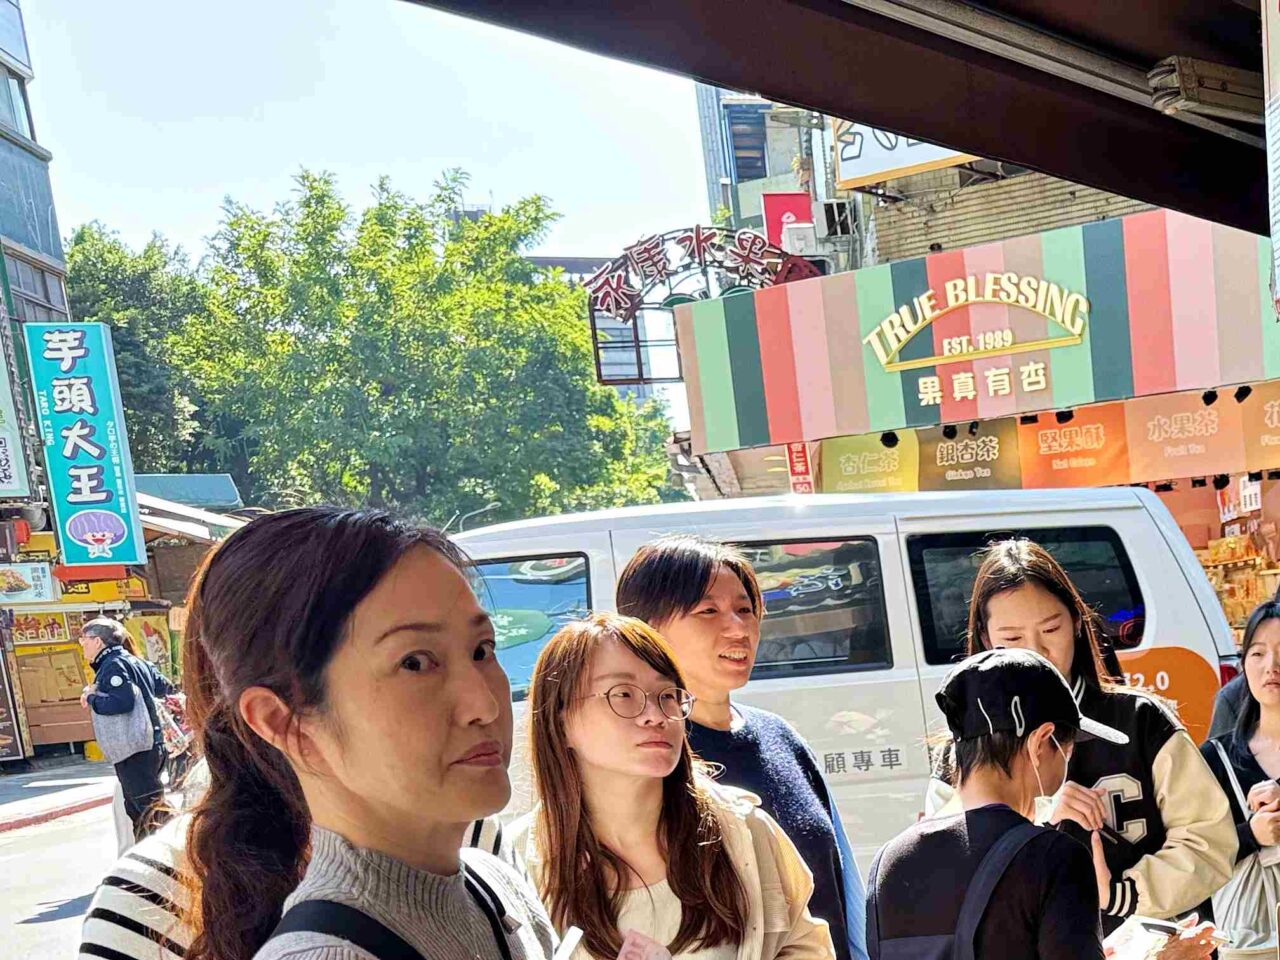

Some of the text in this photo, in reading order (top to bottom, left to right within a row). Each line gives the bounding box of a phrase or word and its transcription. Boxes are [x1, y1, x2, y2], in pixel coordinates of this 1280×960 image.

[862, 272, 1090, 365] TRUE BLESSING
[942, 329, 1013, 356] EST. 1989
[918, 361, 1047, 407] 果真有杏
[37, 391, 49, 417] TARO
[43, 330, 113, 505] 芋頭大王
[1147, 409, 1219, 443] 水果茶
[839, 450, 899, 475] 杏仁茶
[936, 436, 999, 467] 銀杏茶
[825, 747, 903, 774] 顧專車
[1096, 773, 1147, 846] C
